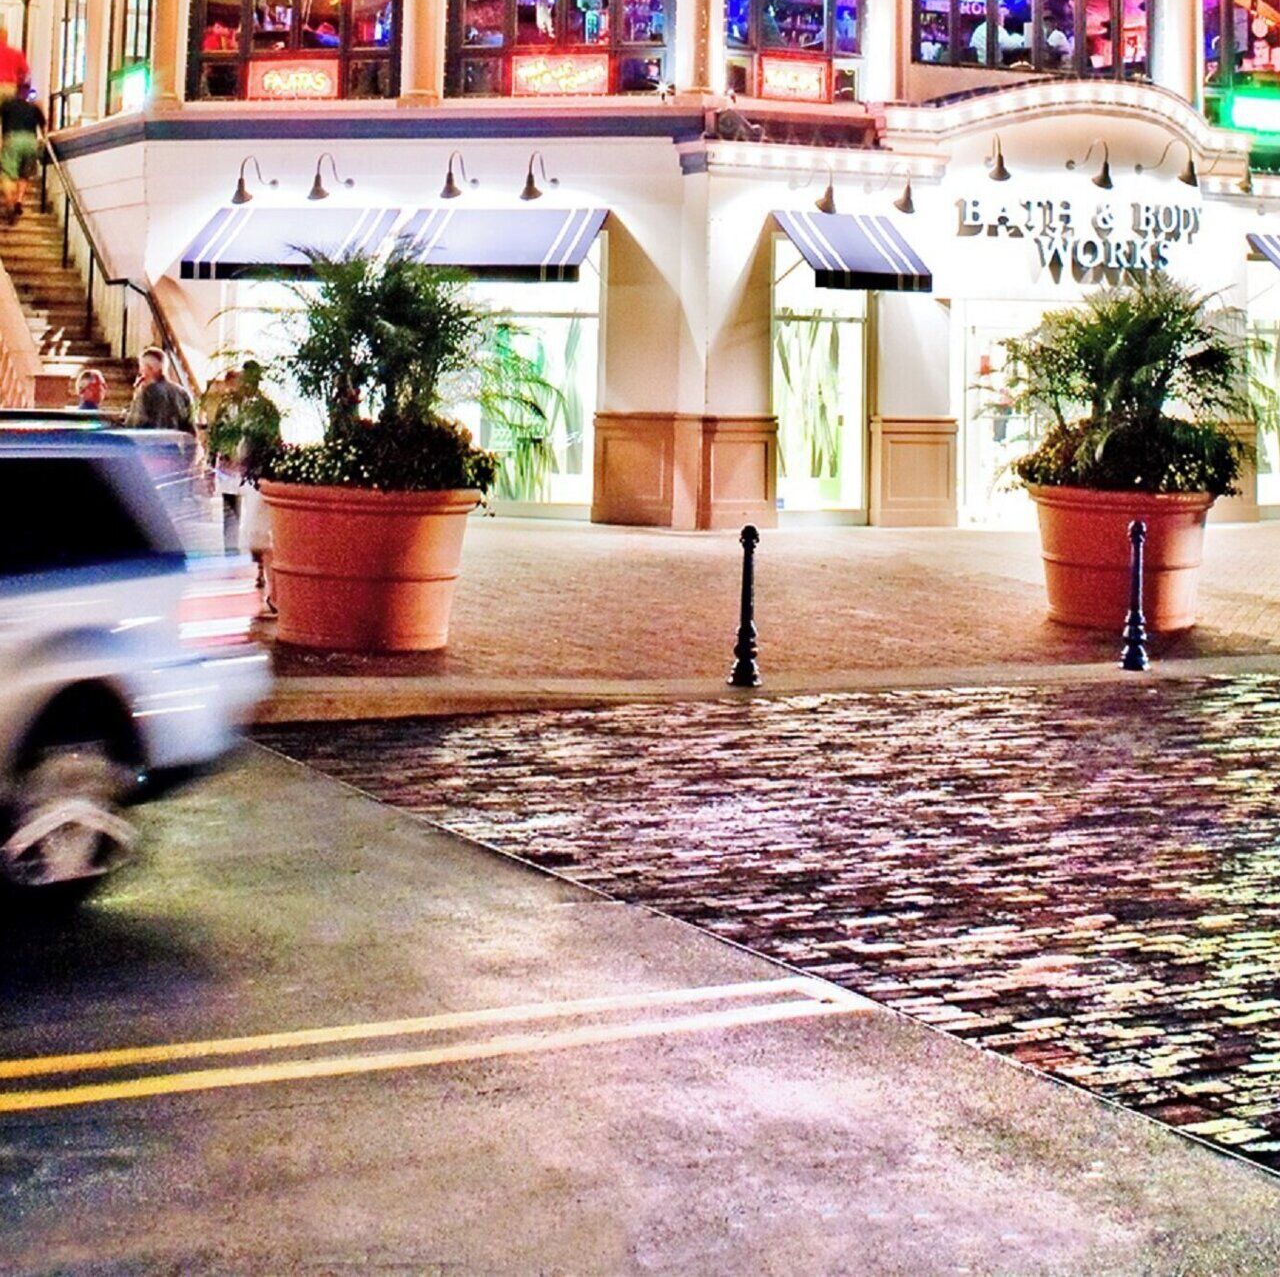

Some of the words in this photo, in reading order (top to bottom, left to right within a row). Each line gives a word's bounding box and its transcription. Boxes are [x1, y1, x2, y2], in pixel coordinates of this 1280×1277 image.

[955, 199, 1074, 234] BATH
[1131, 202, 1202, 240] BODY
[1033, 237, 1170, 272] WORKS
